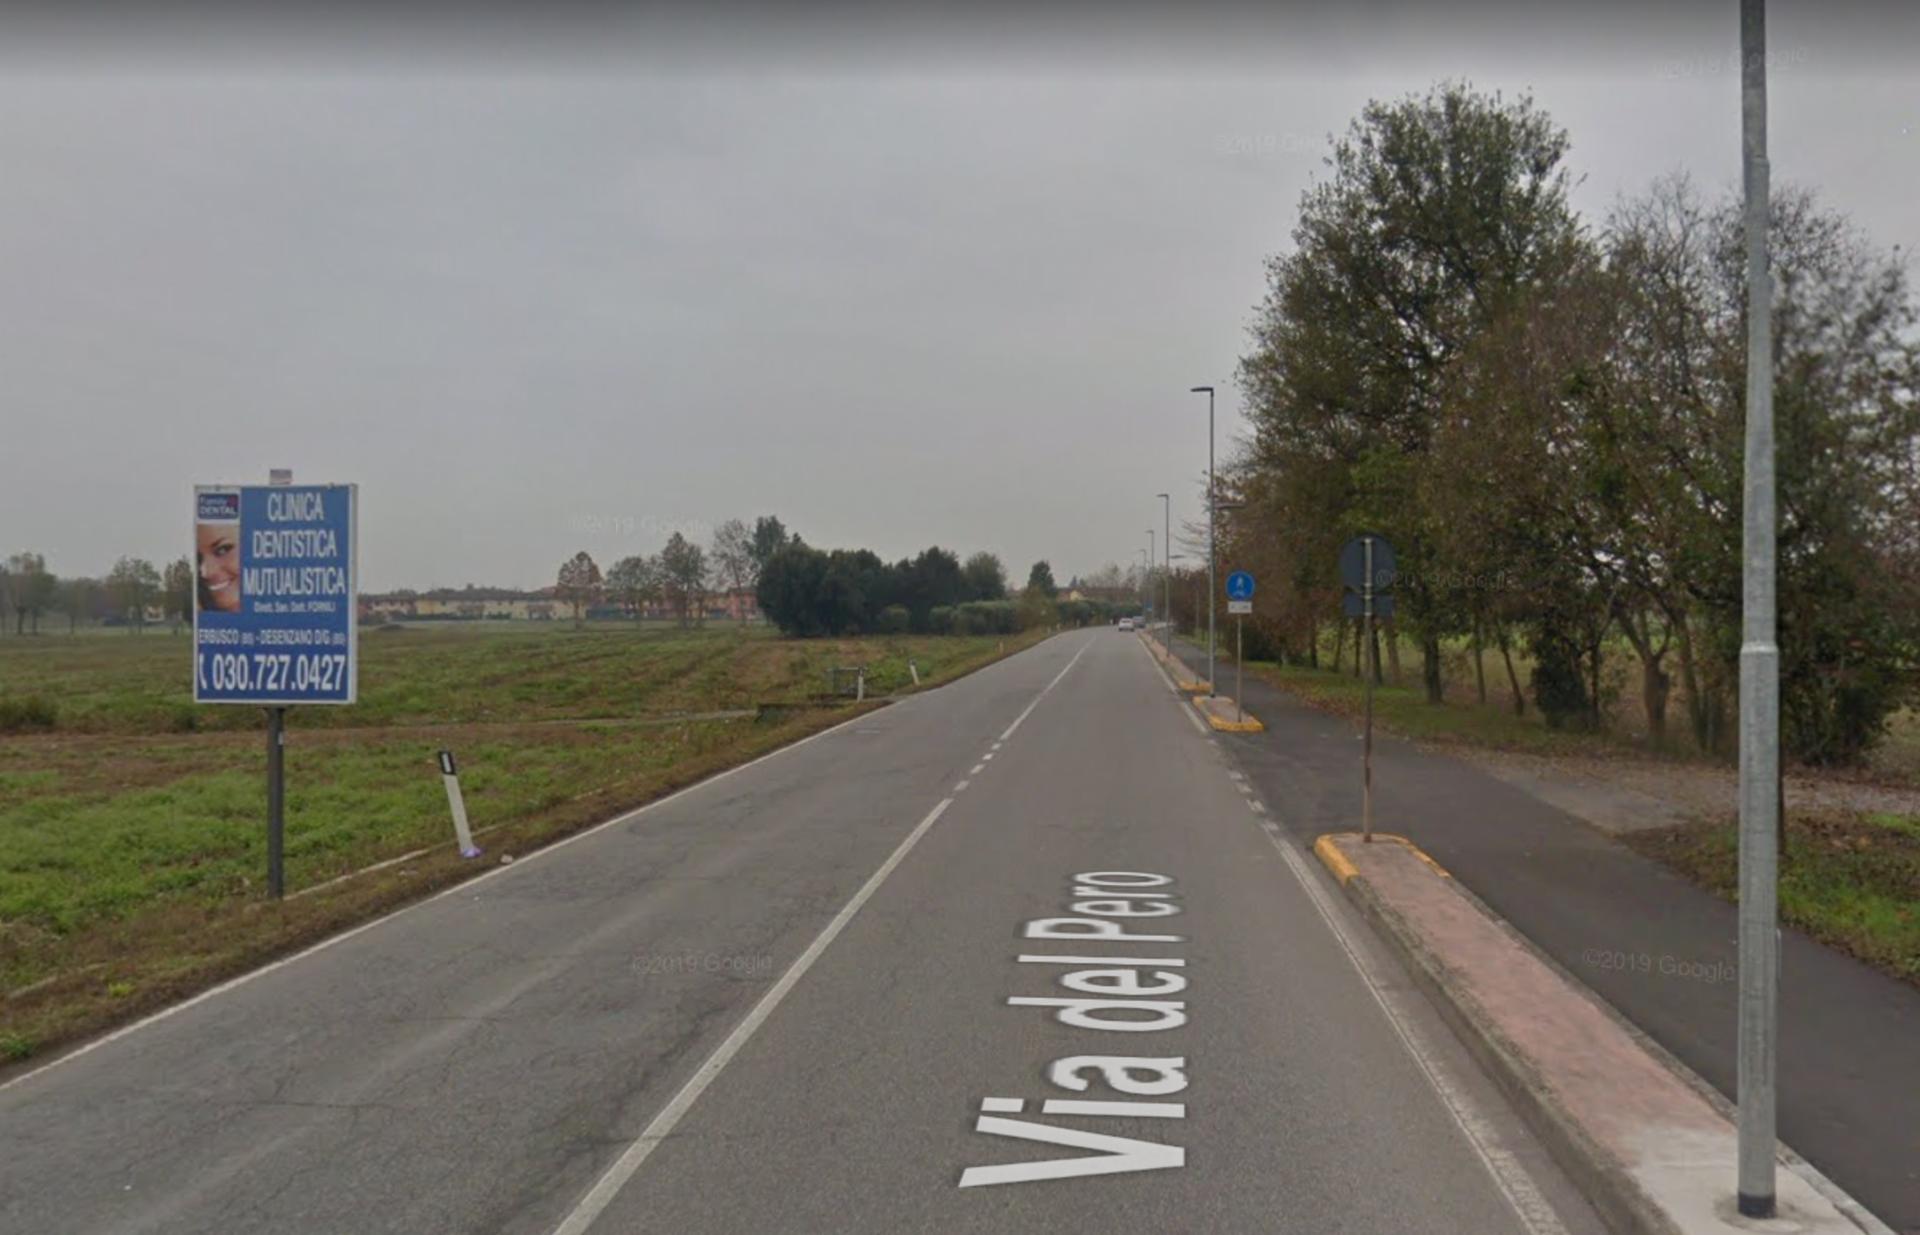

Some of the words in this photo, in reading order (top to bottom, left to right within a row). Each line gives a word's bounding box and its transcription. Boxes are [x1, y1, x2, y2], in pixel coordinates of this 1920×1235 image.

[268, 493, 324, 522] CLINICA
[253, 530, 337, 558] DENTISTICA
[243, 567, 346, 595] MUTUALISTICA
[260, 629, 313, 645] DESENZANO
[212, 653, 346, 690] 030.727.0427
